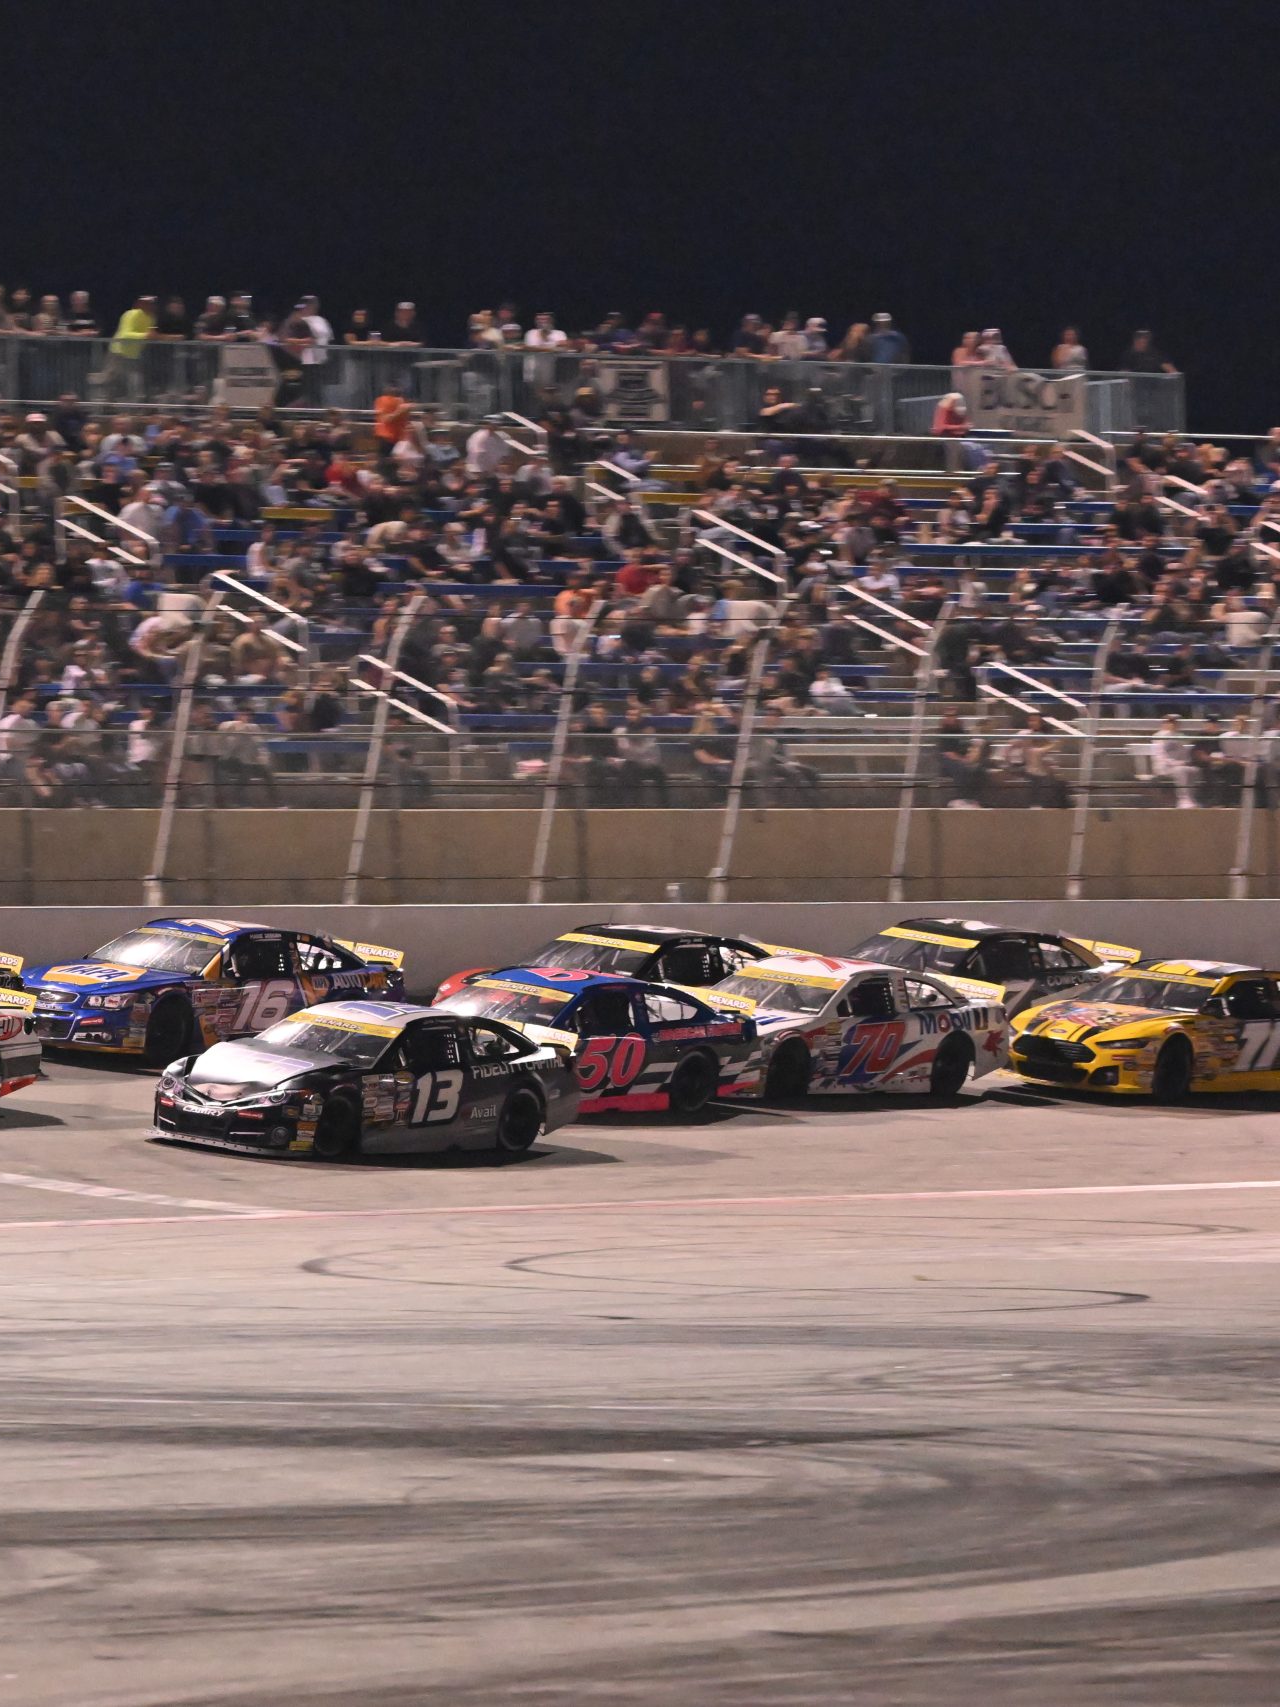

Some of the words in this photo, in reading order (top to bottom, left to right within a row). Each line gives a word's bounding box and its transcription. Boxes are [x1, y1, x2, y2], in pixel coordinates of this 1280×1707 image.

[357, 945, 400, 960] MENARDS
[231, 979, 297, 1031] 16
[708, 995, 753, 1011] MENARDS
[575, 1032, 646, 1090] 50
[838, 1020, 906, 1076] 70
[182, 1105, 225, 1117] CAMRY
[410, 1069, 464, 1124] 13
[471, 1104, 497, 1119] Avail
